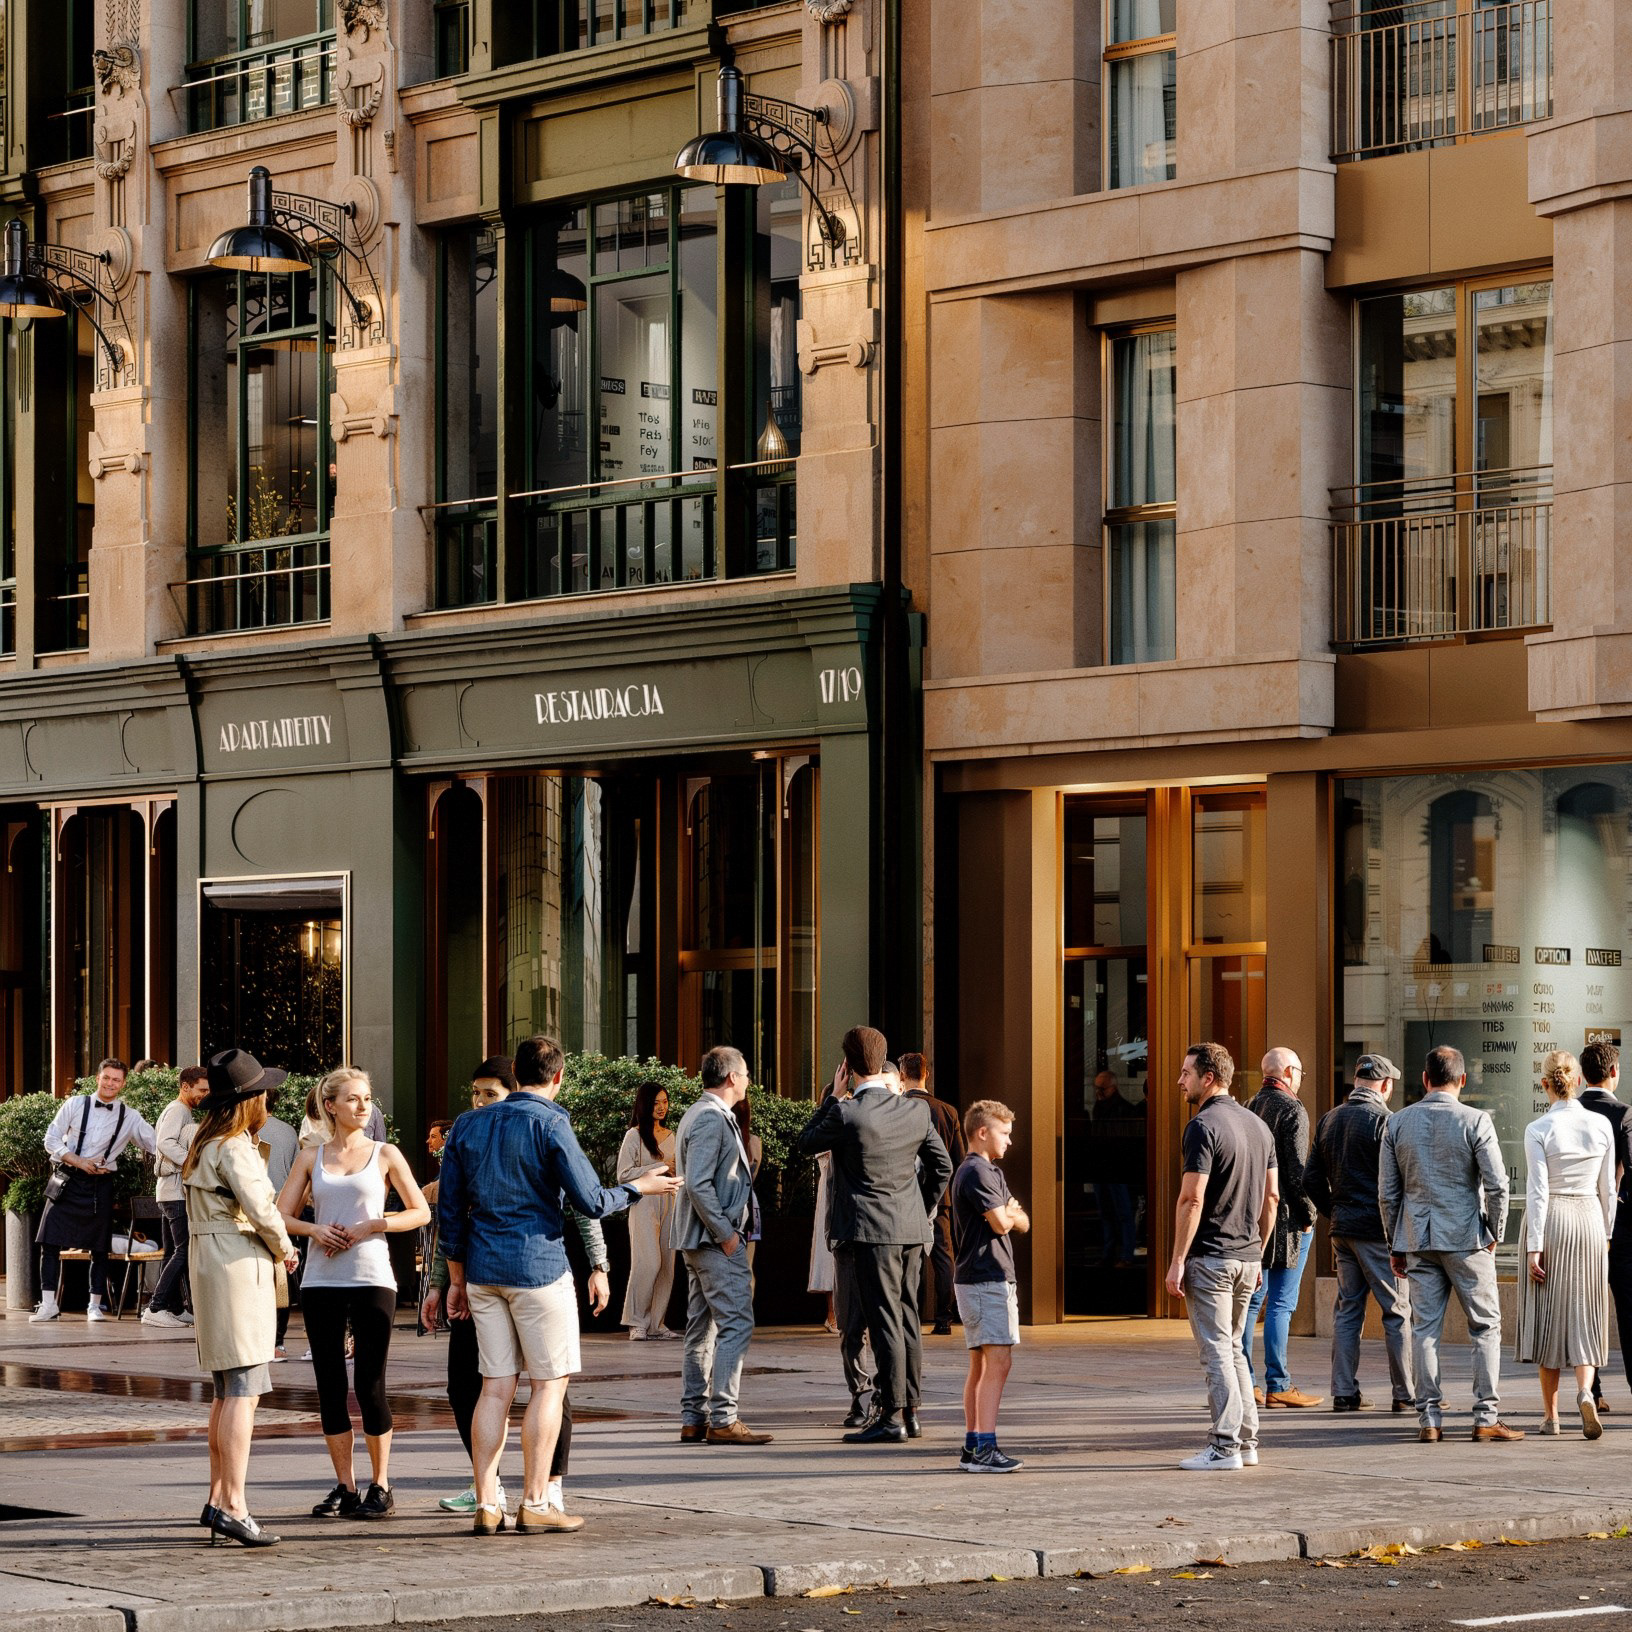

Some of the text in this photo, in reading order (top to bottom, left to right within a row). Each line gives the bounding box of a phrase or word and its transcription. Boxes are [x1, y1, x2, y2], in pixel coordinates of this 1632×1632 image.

[534, 684, 664, 724] RESTAURACJA
[219, 715, 331, 752] APARTAMENTY
[1536, 948, 1568, 963] OPTION
